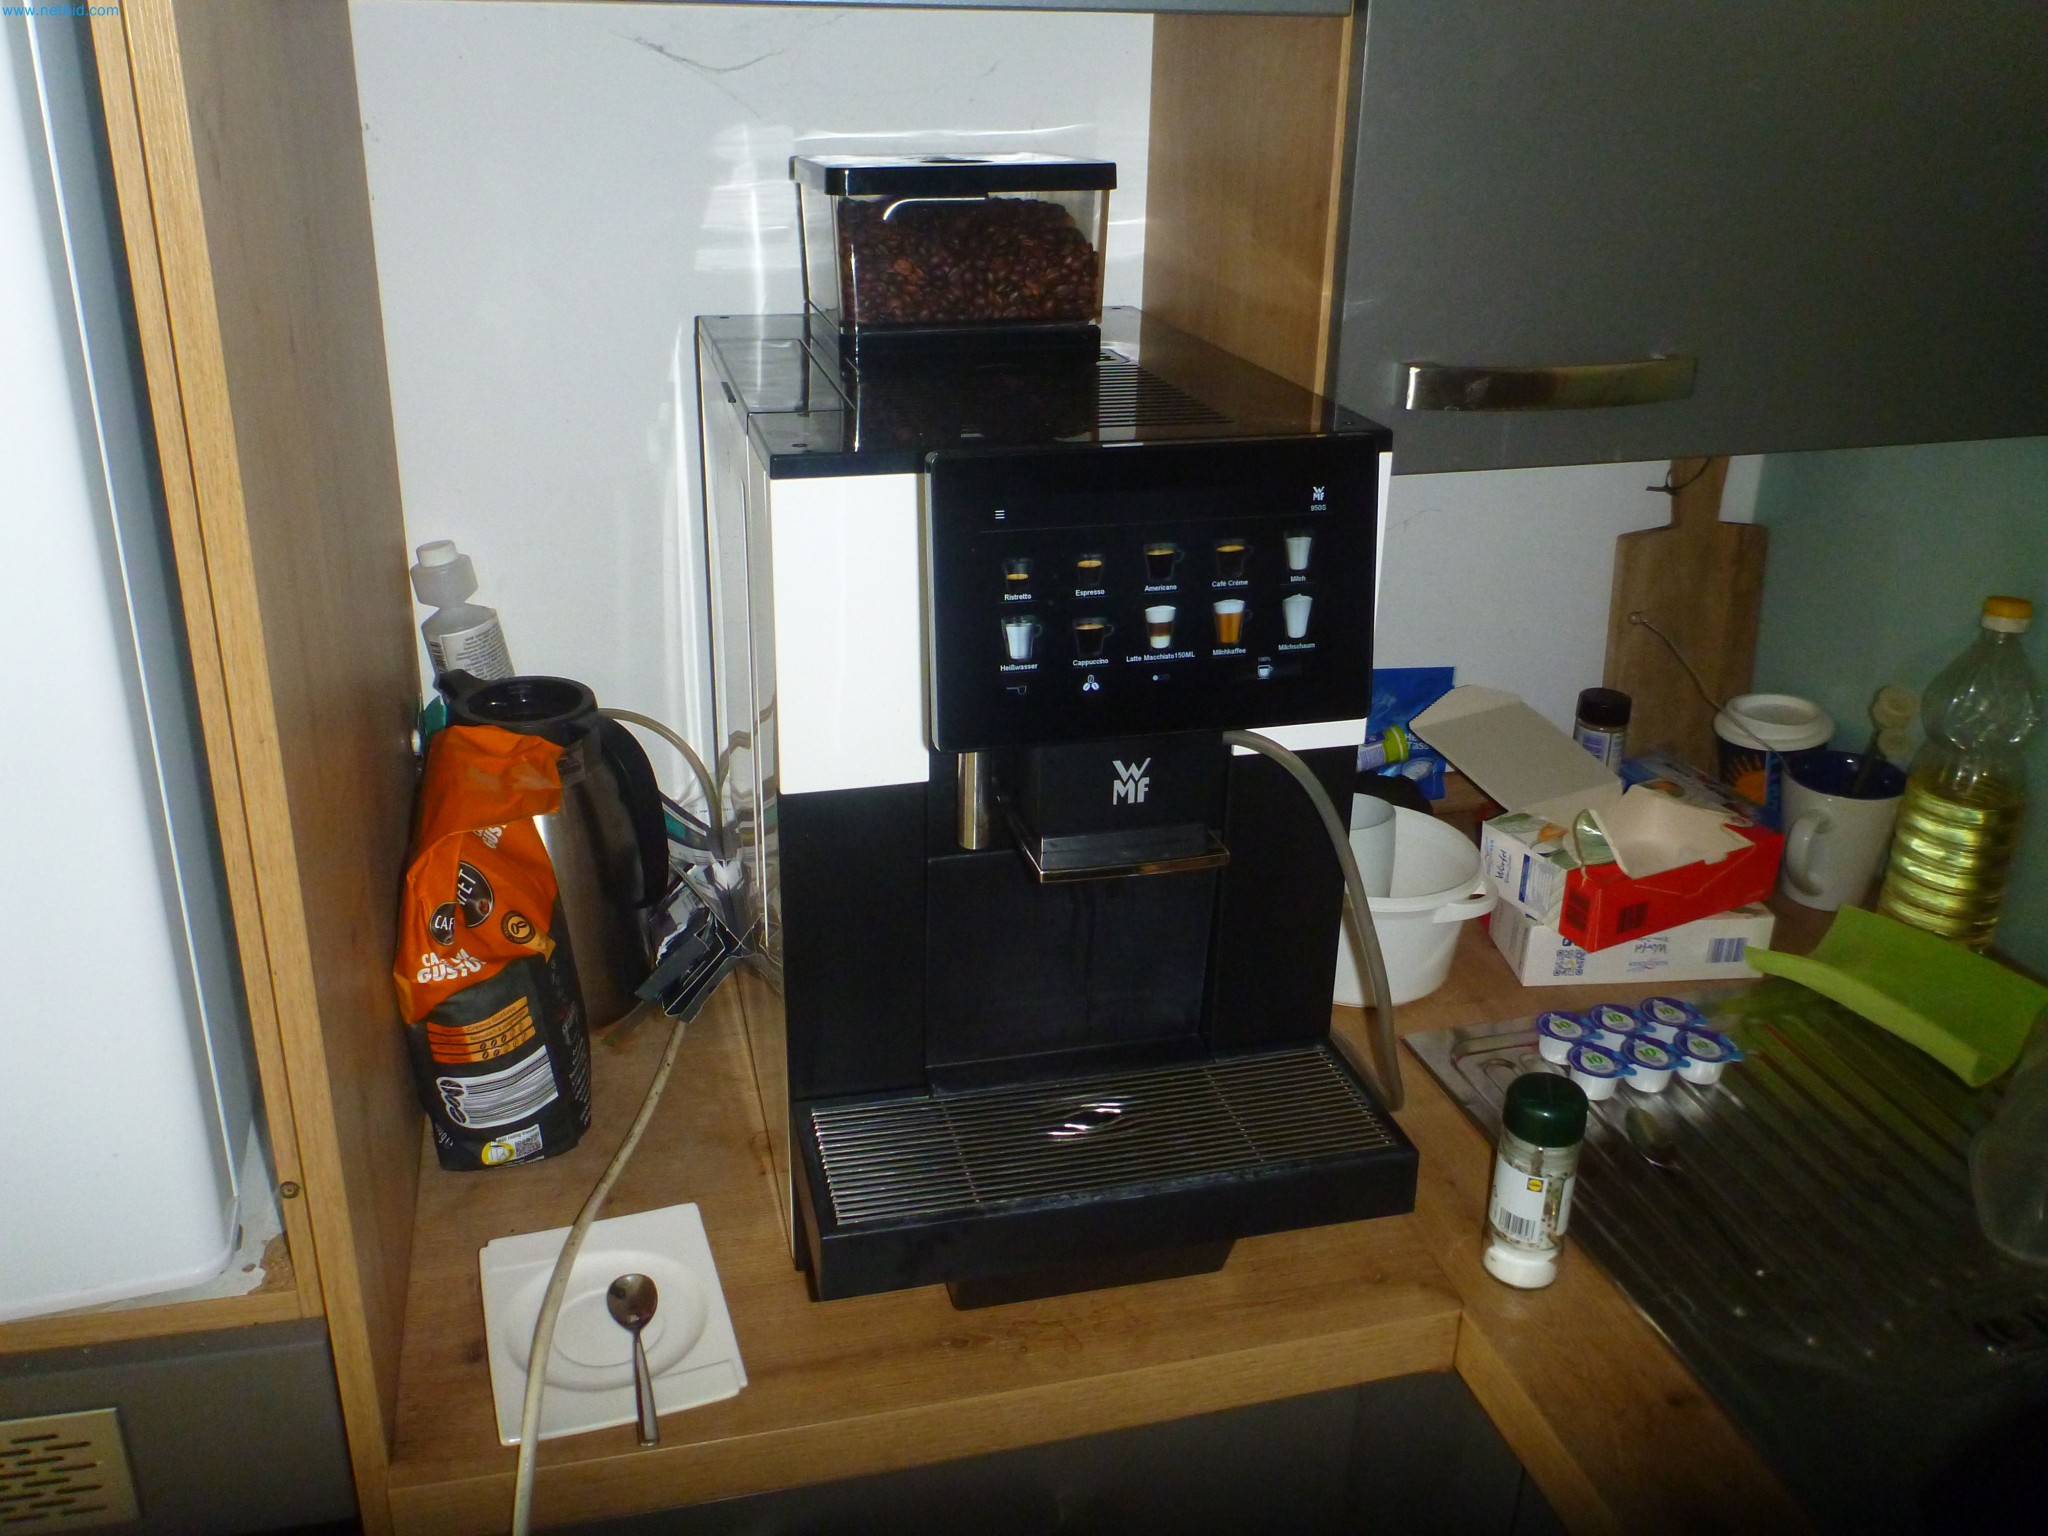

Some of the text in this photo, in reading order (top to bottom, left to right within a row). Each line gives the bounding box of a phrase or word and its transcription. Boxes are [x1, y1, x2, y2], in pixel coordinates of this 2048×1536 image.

[1312, 486, 1325, 501] WMF
[1144, 583, 1177, 592] Americano
[1211, 579, 1227, 588] Café
[1004, 593, 1032, 601] Ristretto
[1075, 588, 1105, 598] Espresso
[1212, 647, 1247, 656] Milchkaffee
[1278, 642, 1316, 651] Milchschaum
[1072, 658, 1109, 668] Cappuccino
[1126, 655, 1142, 663] Latte
[1000, 663, 1038, 673] Heißwasser
[1112, 757, 1151, 805] WMF
[1606, 1013, 1624, 1023] 10
[1556, 1020, 1572, 1030] 10
[1691, 1039, 1710, 1049] 10
[1637, 1047, 1657, 1057] 10
[1585, 1054, 1604, 1065] 10
